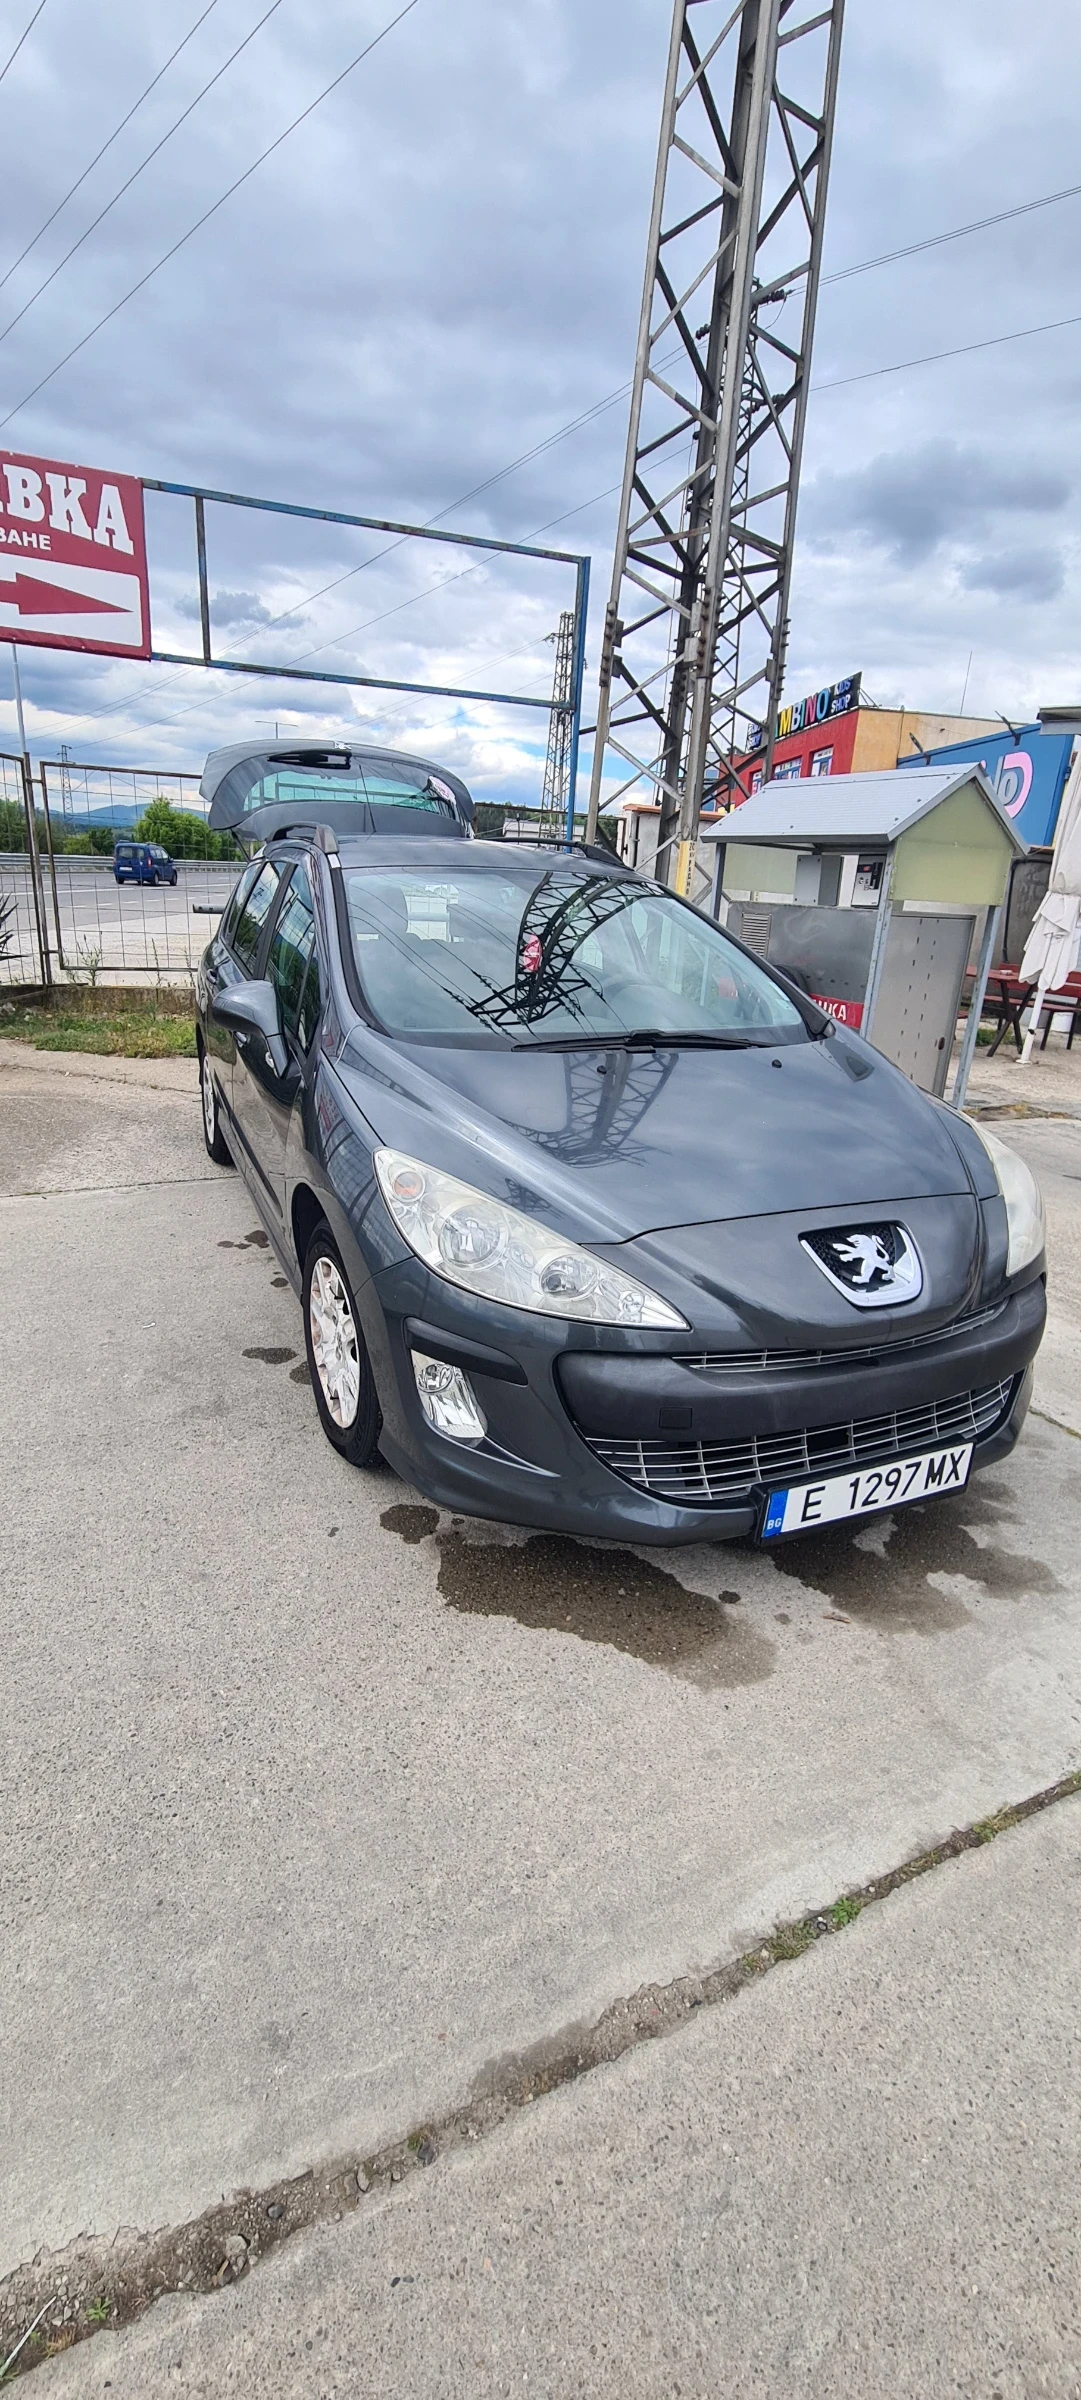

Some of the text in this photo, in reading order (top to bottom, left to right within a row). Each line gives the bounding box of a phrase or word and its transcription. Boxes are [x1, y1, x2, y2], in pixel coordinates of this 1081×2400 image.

[0, 464, 134, 555] ВКА
[831, 694, 851, 714] SHOP
[801, 1485, 826, 1523] E
[767, 1517, 782, 1530] BG
